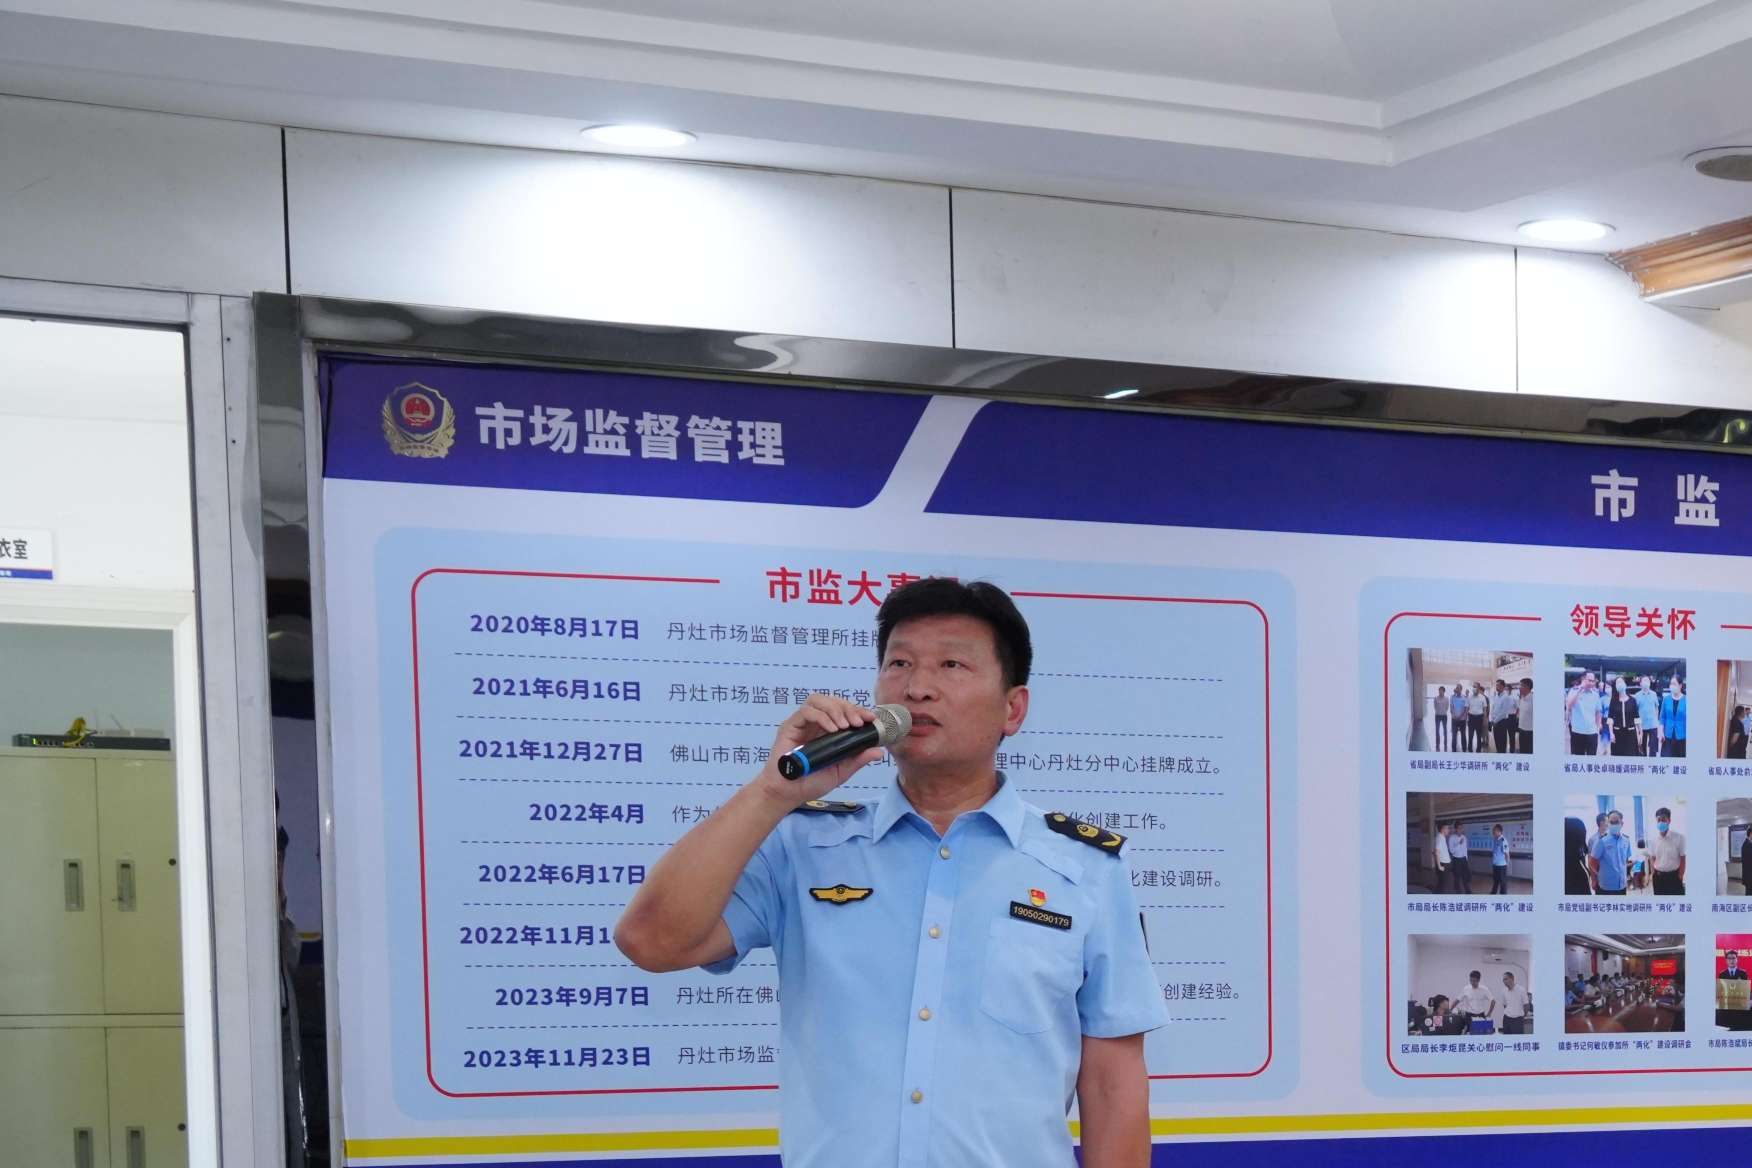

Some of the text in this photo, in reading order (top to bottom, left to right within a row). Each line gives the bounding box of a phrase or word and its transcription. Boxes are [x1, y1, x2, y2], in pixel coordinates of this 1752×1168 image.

[475, 402, 786, 466] 市场监督管理
[766, 566, 960, 607] 市监大
[469, 613, 641, 642] 2020年8月17日
[1570, 603, 1697, 641] 领导关怀
[472, 677, 642, 702] 2021年6月16日
[459, 739, 643, 764] 2021年12月27日
[529, 802, 646, 825] 2022年4月
[672, 805, 719, 824] 作为
[479, 864, 646, 885] 2022年6月17日
[460, 925, 613, 947] 2022年11月1
[495, 986, 650, 1007] 2023年9月7日
[676, 985, 781, 1005] 丹灶所在佛
[463, 1045, 780, 1069] 2023年11月23日 丹灶市场监
